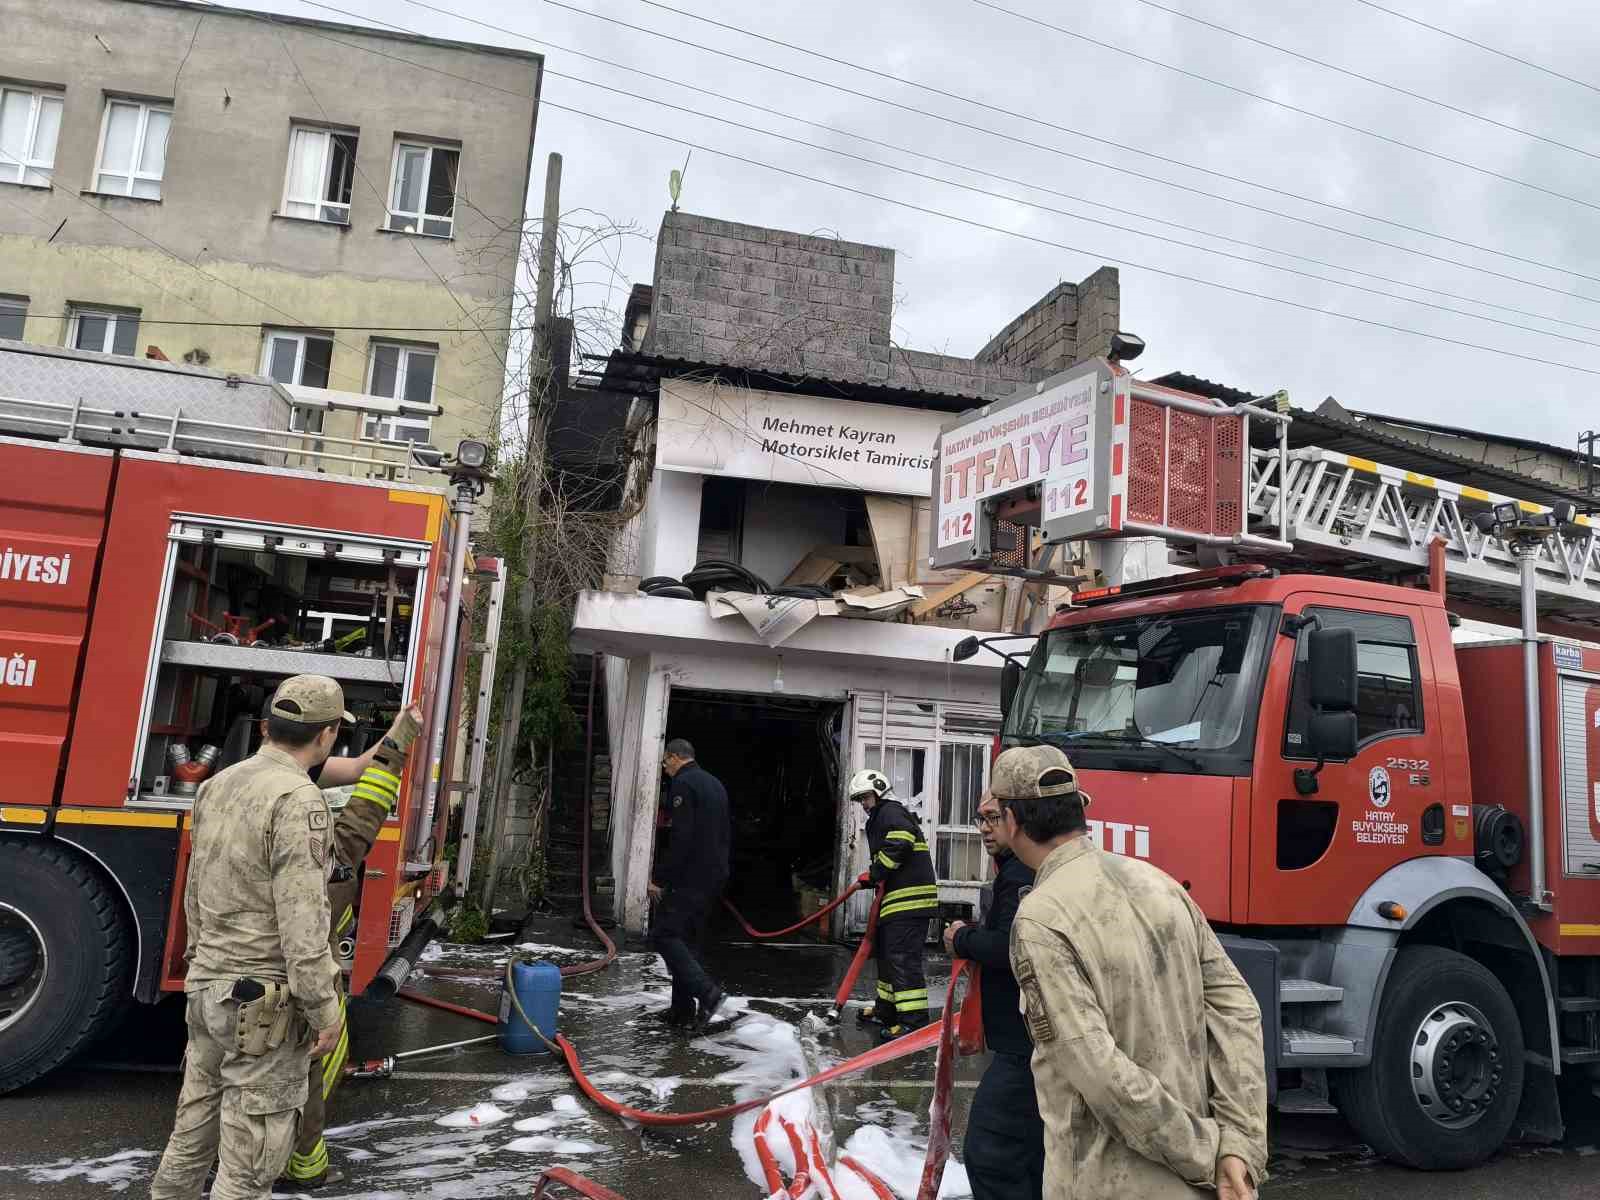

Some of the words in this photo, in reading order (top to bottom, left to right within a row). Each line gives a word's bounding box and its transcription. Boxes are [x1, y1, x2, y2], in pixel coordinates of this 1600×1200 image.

[762, 416, 834, 438] Mehmet
[838, 425, 896, 445] Kayran
[761, 438, 860, 463] Motorsiklet
[945, 438, 971, 457] HATAY
[1046, 478, 1089, 513] 112
[942, 511, 973, 541] 112
[0, 547, 71, 585] İYESİ
[1386, 757, 1430, 771] 2532
[1365, 810, 1395, 822] HATAY
